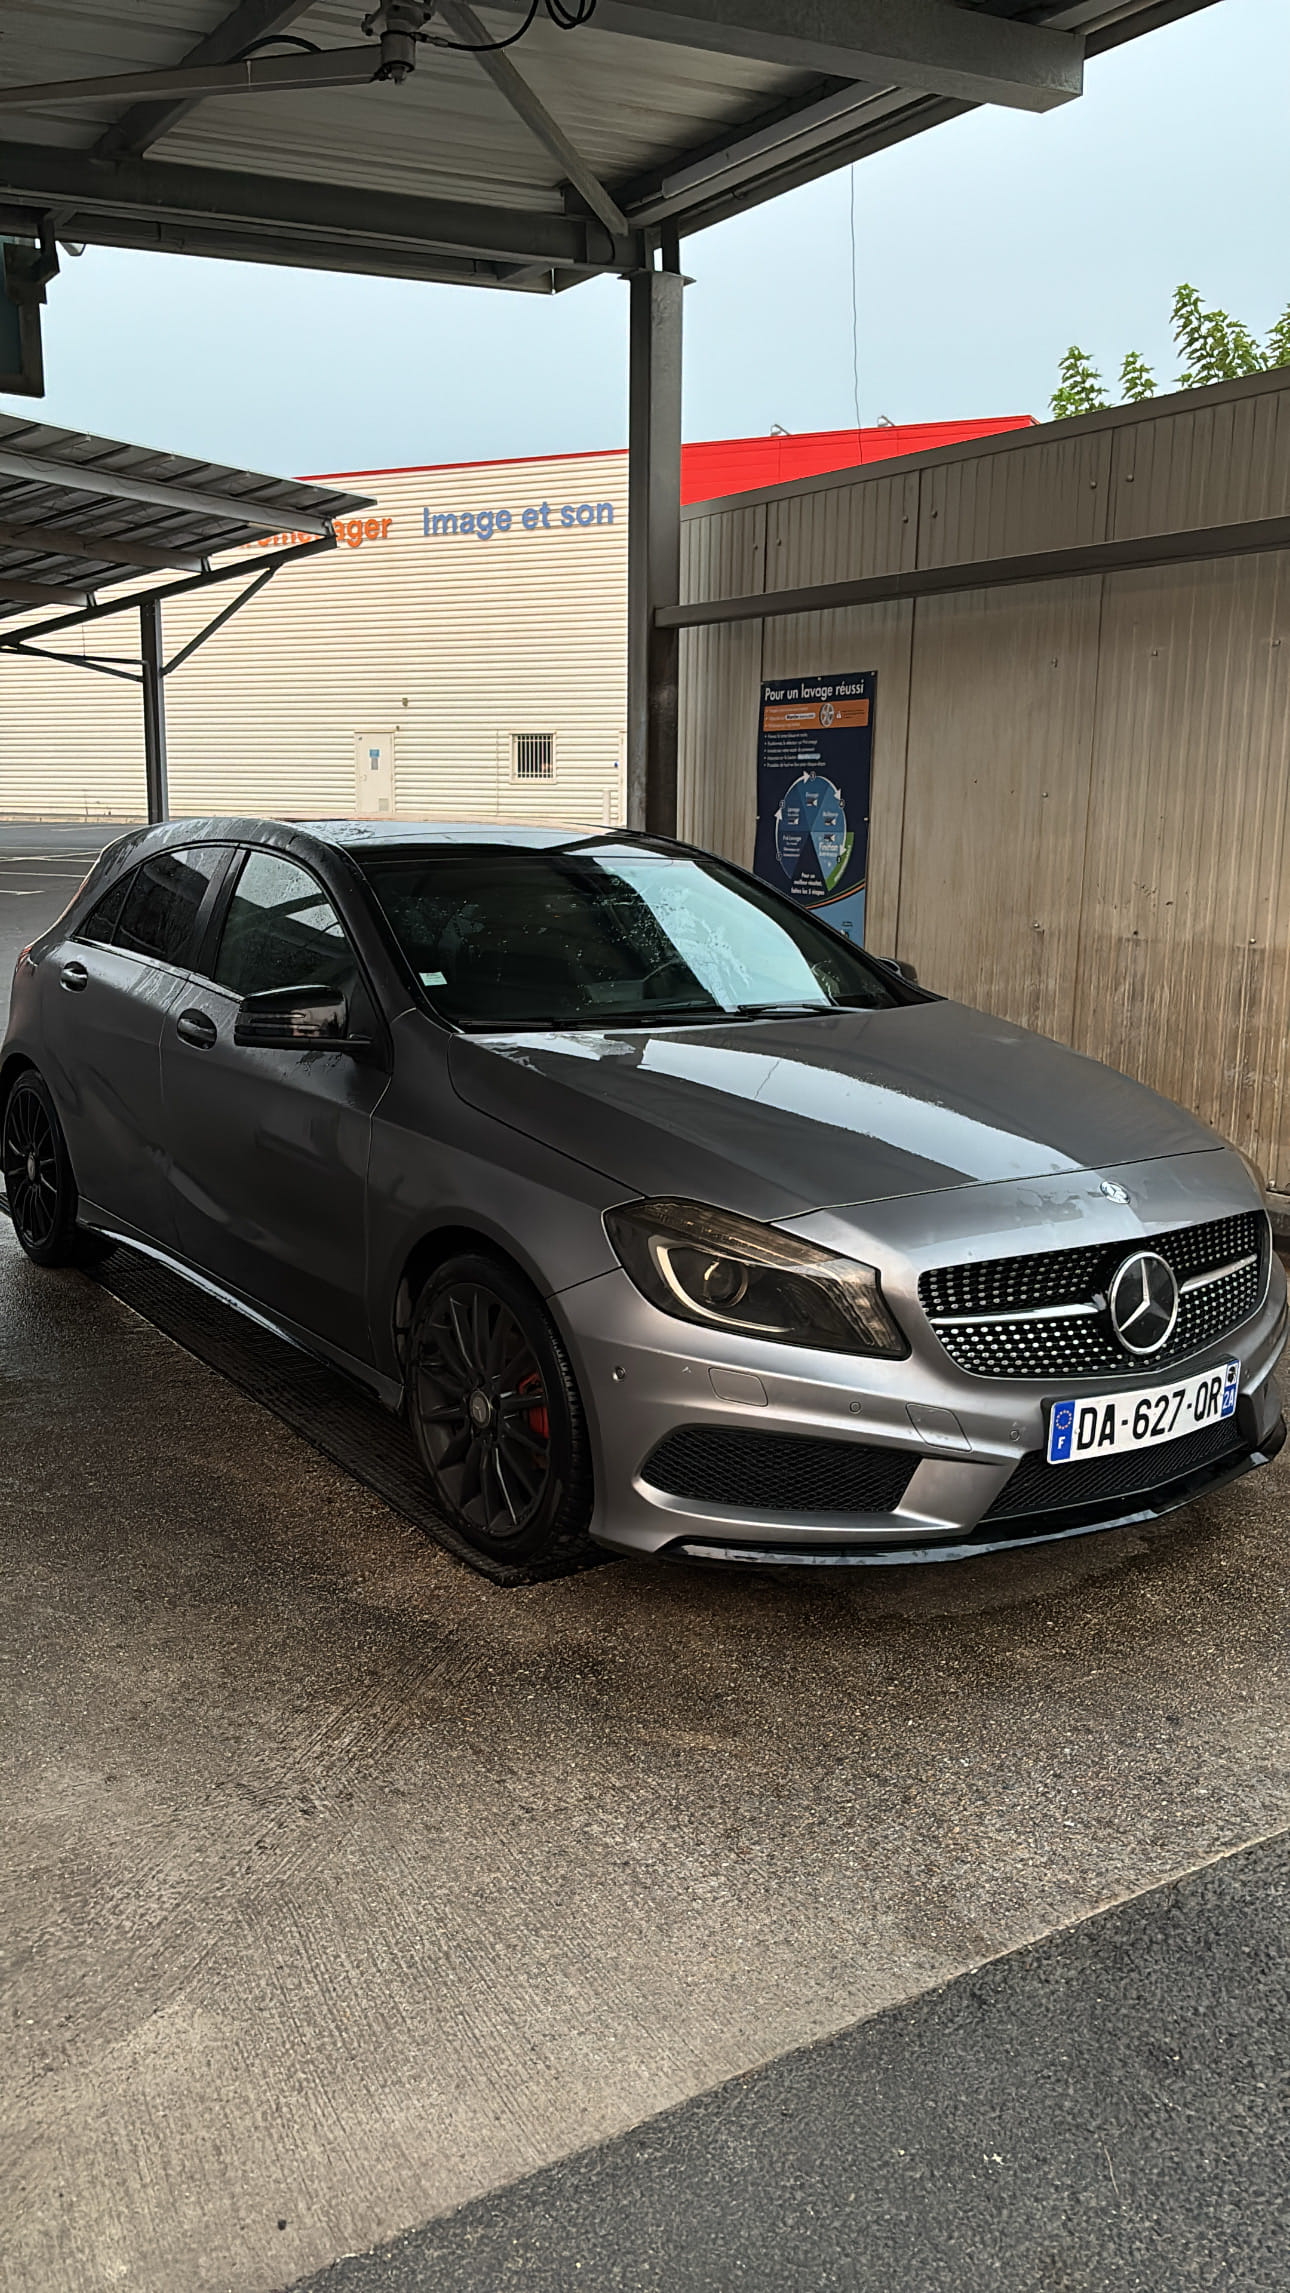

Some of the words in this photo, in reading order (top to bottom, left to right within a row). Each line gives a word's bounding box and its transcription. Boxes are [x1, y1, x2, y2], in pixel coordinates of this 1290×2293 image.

[423, 507, 512, 540] Image
[521, 501, 551, 530] et
[560, 502, 614, 527] son
[765, 687, 785, 701] Pour
[786, 689, 799, 700] un
[801, 683, 833, 701] lavage
[835, 679, 865, 695] réussi
[1222, 1388, 1235, 1410] 2A
[1057, 1436, 1066, 1450] F
